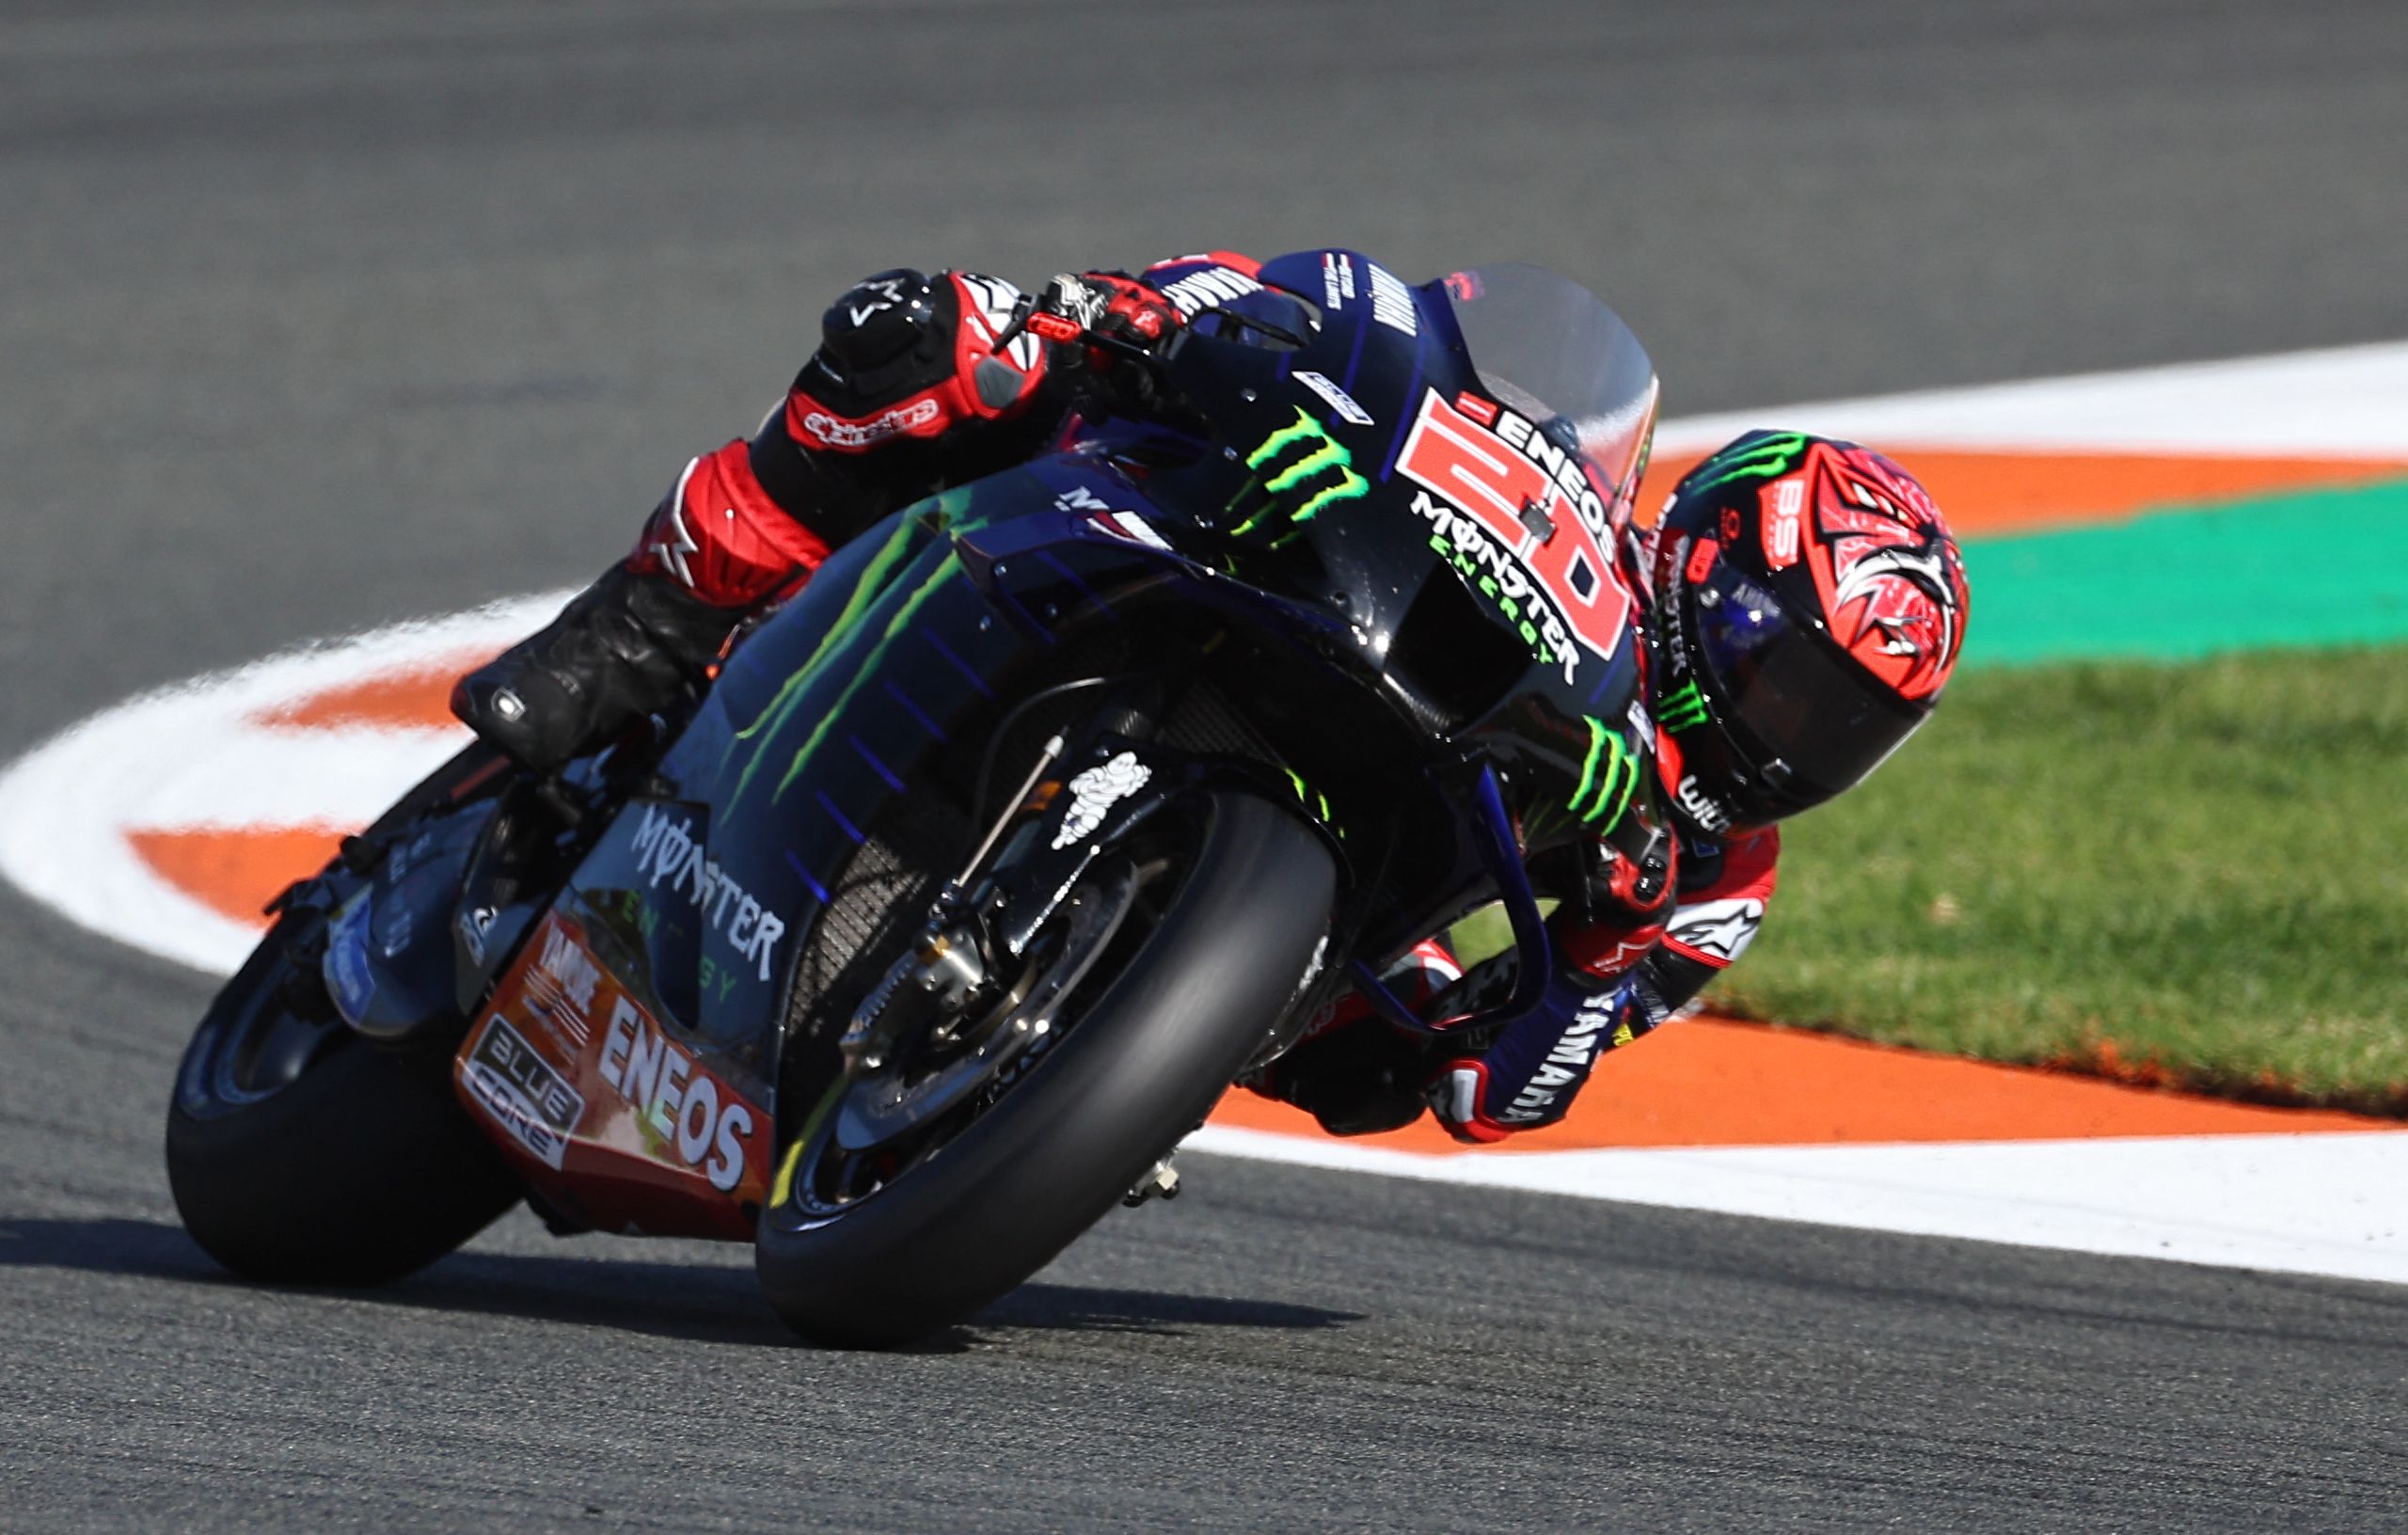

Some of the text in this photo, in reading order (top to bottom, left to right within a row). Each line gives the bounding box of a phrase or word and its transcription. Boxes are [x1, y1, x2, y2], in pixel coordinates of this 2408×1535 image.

[1395, 387, 1631, 661] 20
[1495, 410, 1615, 563] ENEOS
[1411, 490, 1580, 686] MONSTER
[1429, 533, 1554, 663] ENERGY
[630, 803, 785, 982] MONSTER
[471, 1067, 563, 1156] CORE
[488, 1033, 572, 1123] BLUE
[598, 993, 752, 1192] ENEOS
[1505, 989, 1615, 1123] YAMAHA
